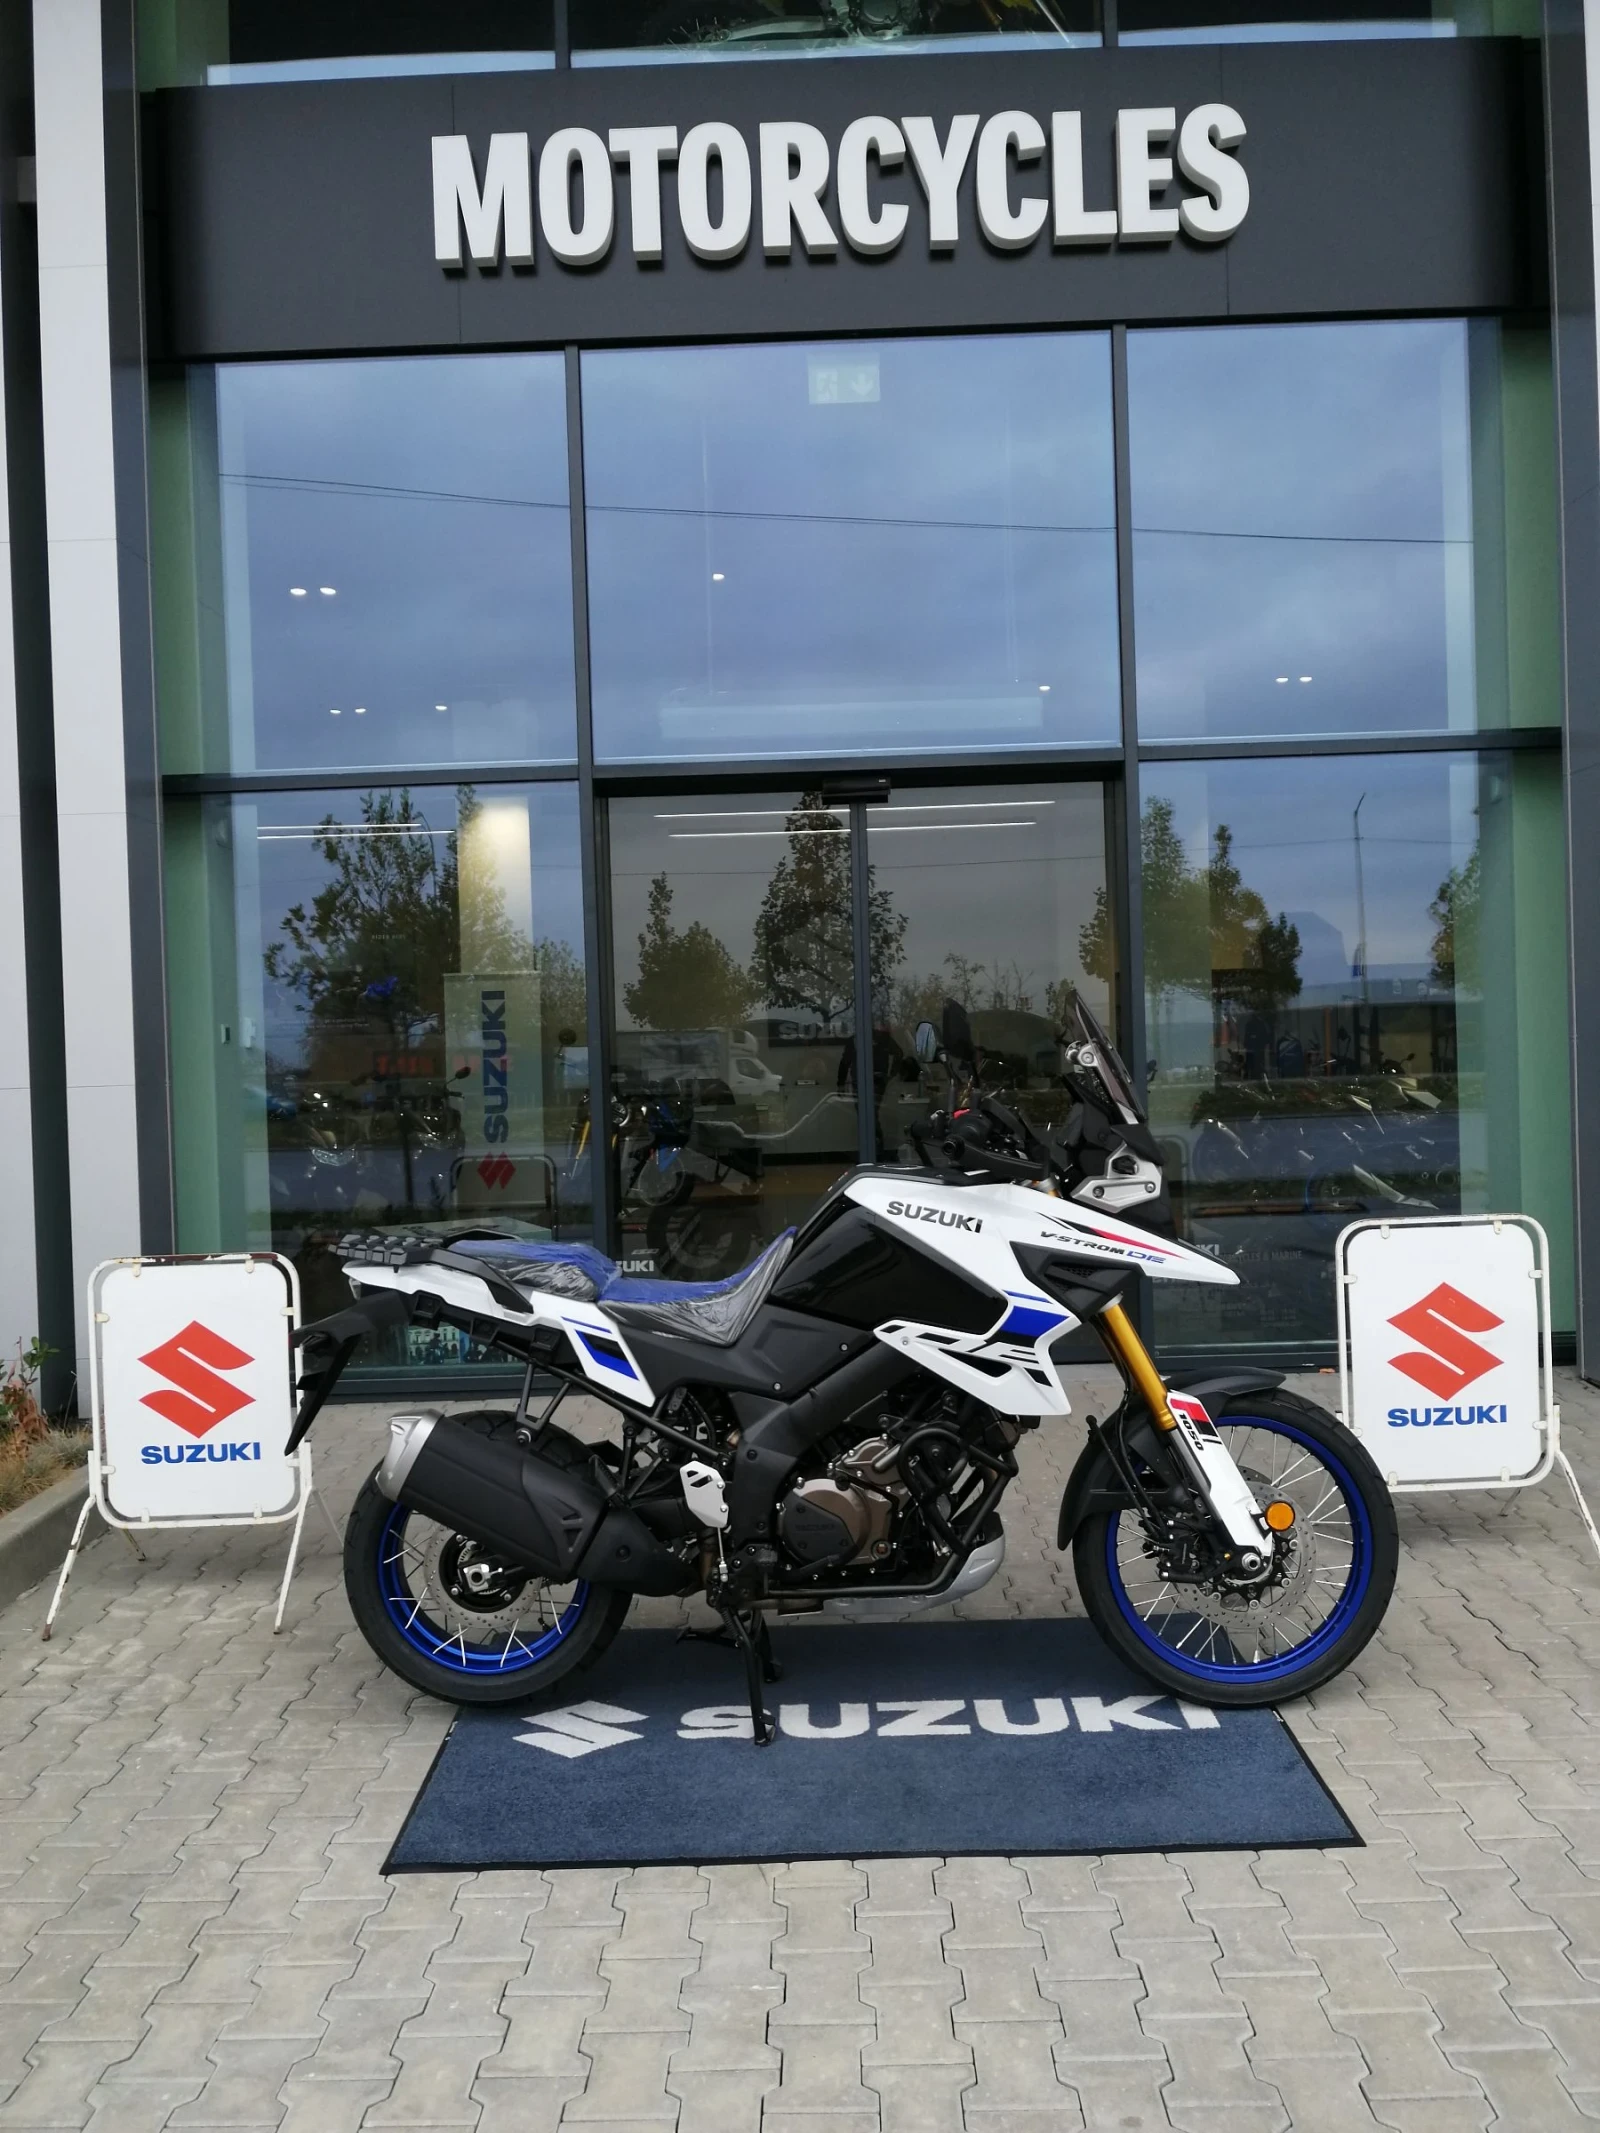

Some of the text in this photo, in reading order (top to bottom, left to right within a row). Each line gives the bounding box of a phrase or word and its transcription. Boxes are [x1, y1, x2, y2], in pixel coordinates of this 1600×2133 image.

[431, 103, 1250, 269] MOTORCYCLES
[778, 1022, 855, 1040] SUZU
[481, 990, 509, 1144] SUZUKI
[886, 1201, 983, 1233] SUZUKI
[1040, 1231, 1167, 1264] V-STROM DE
[1179, 1413, 1204, 1451] 1050
[1387, 1404, 1507, 1427] SUZUKI
[141, 1442, 260, 1464] SUZUKI
[676, 1695, 1221, 1740] SUZUKI
